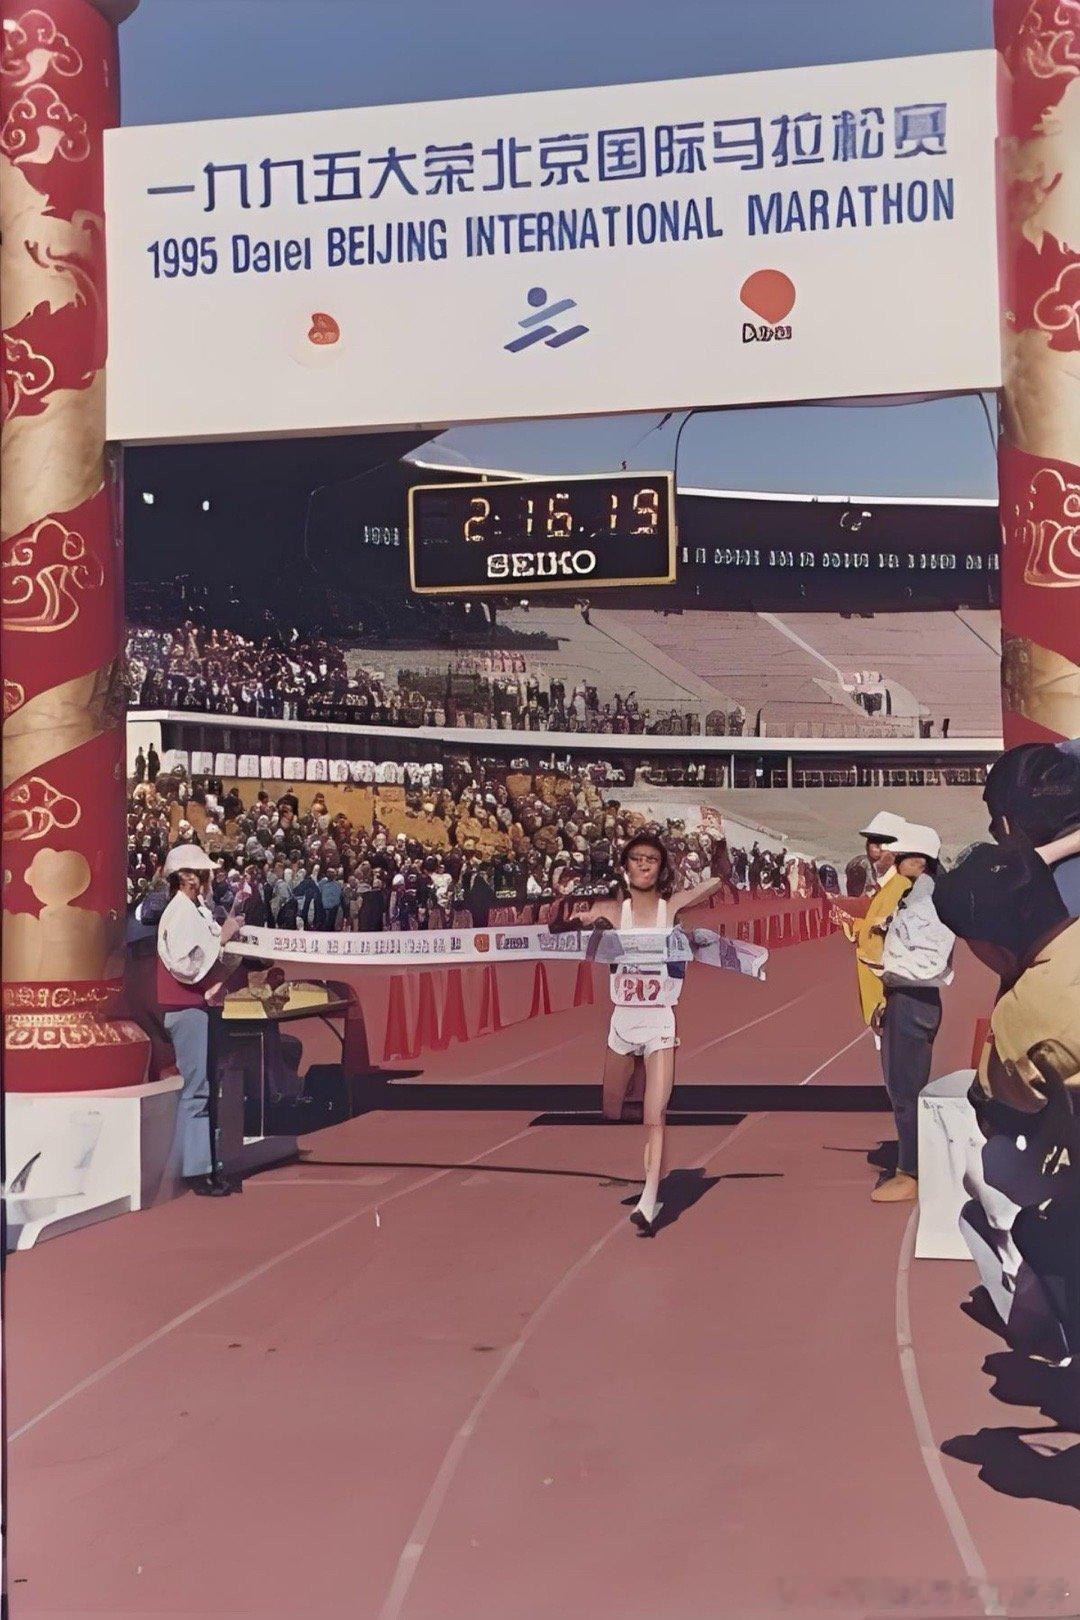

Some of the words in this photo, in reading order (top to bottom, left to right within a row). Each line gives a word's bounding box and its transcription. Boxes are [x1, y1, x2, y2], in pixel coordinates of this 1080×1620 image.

[147, 237, 218, 278] 1995
[328, 219, 447, 267] BEIJING
[466, 197, 723, 257] INTERNATIONAL
[748, 178, 954, 244] MARATHON
[487, 549, 596, 577] SEIKO
